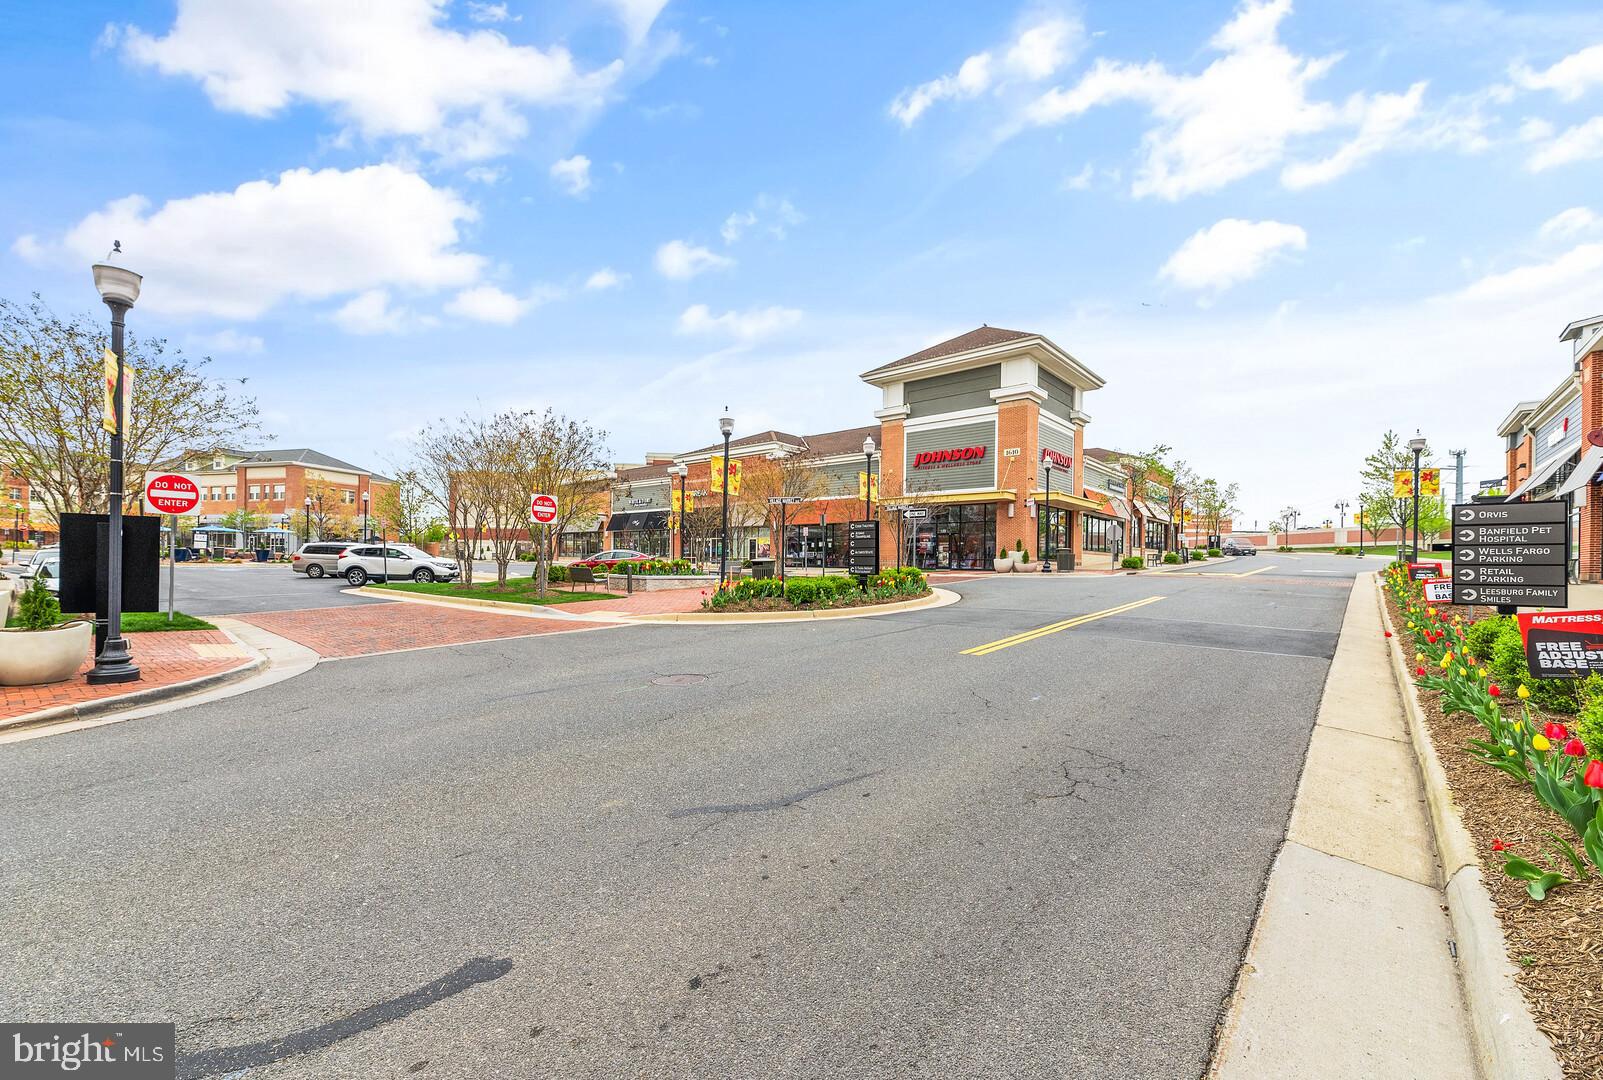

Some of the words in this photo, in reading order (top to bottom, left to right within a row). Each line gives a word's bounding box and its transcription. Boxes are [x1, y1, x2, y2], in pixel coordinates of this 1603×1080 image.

[912, 446, 986, 467] JOHNSON
[174, 482, 192, 490] NOT
[158, 499, 188, 507] ENTER
[1479, 527, 1529, 536] BANFIELD
[1531, 526, 1552, 534] PET
[1479, 547, 1513, 555] WELLS
[1516, 547, 1550, 555] FARGO
[1480, 567, 1514, 575] RETAIL
[1480, 587, 1524, 596] LEESBURG
[1526, 588, 1559, 597] FAMILY
[1480, 595, 1511, 603] SMILES
[1532, 614, 1602, 624] MATTRESS
[1535, 641, 1583, 651] FREE
[1538, 650, 1603, 660] ADJUST
[1539, 659, 1589, 669] BASE
